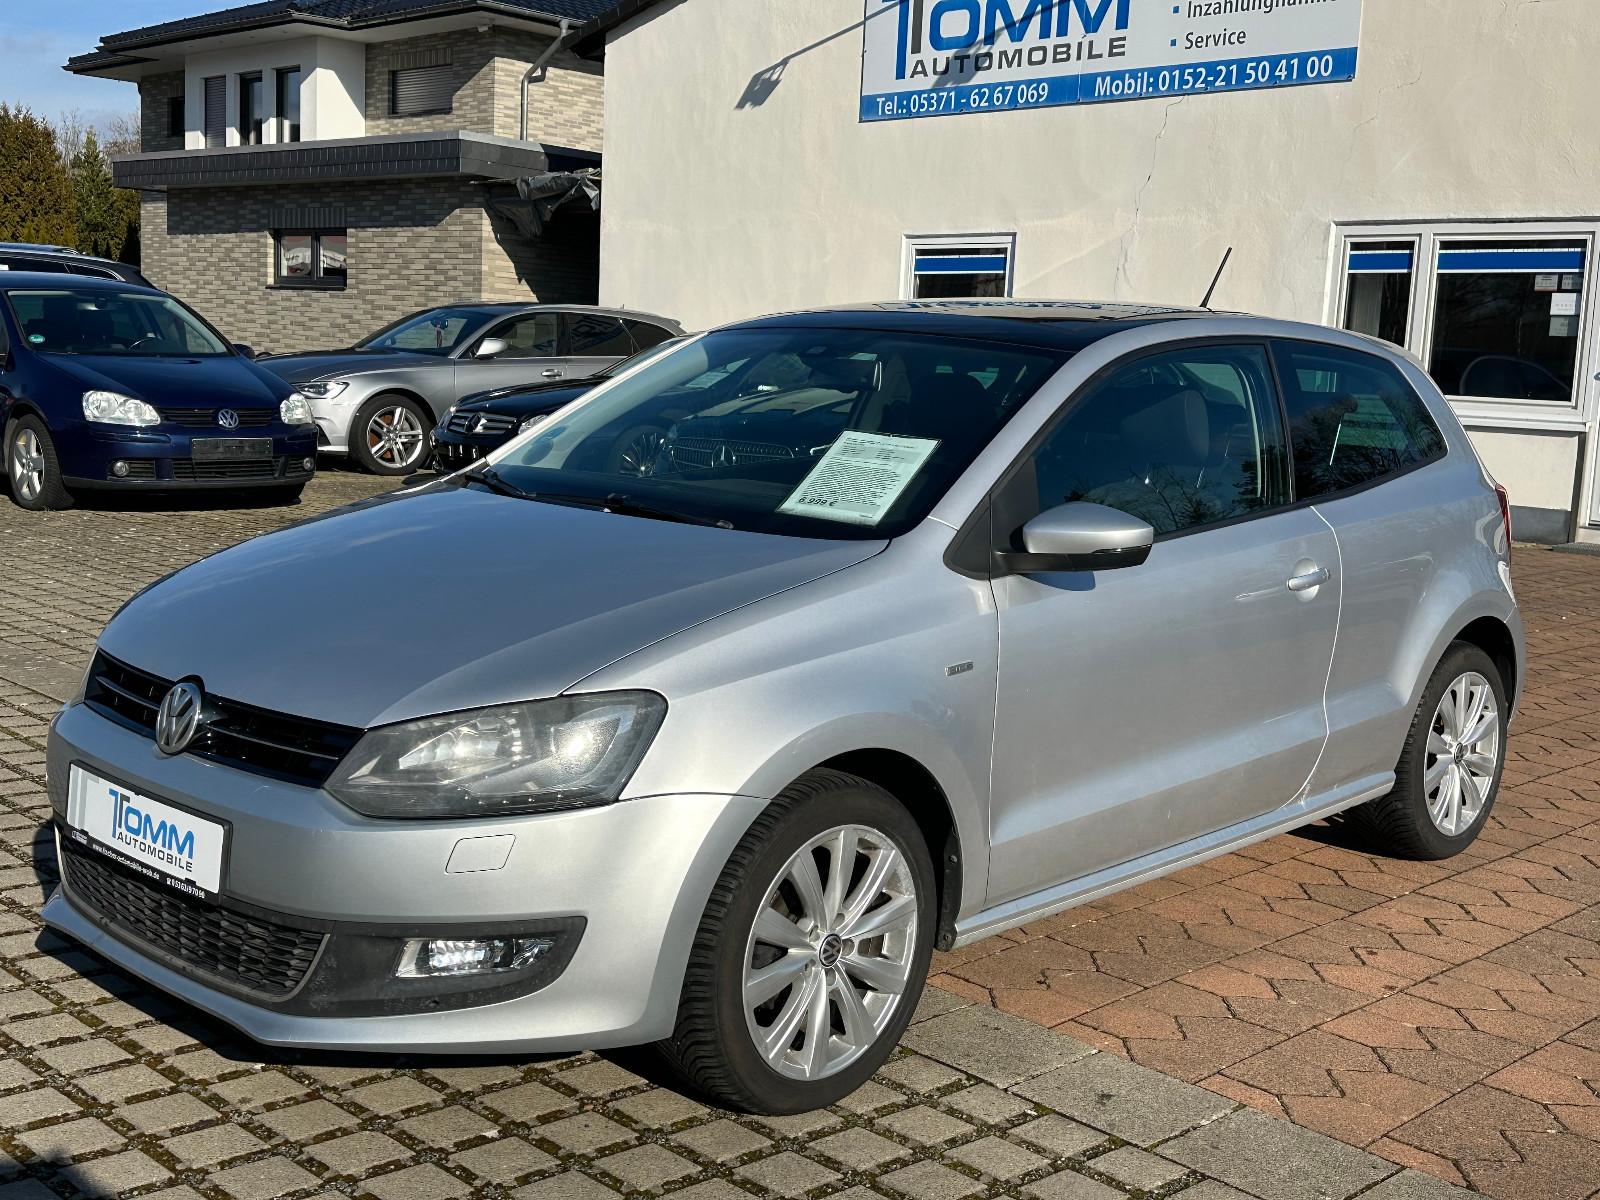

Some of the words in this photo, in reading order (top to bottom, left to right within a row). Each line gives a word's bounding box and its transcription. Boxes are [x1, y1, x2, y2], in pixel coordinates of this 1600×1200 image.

[882, 0, 1131, 80] TOMM
[909, 36, 1127, 79] AUTOMOBILE
[1184, 28, 1247, 50] Service
[1094, 72, 1154, 97] Mobil:
[1158, 64, 1237, 92] 0152-21
[1244, 60, 1270, 83] 50
[1275, 58, 1299, 81] 41
[1306, 55, 1334, 77] 00
[876, 95, 907, 116] Tel.:
[910, 91, 956, 113] 05371
[970, 88, 989, 108] 62
[993, 86, 1012, 106] 67
[1017, 82, 1049, 103] 069
[108, 787, 195, 860] TOMM
[116, 831, 193, 873] AUTOMOBILE
